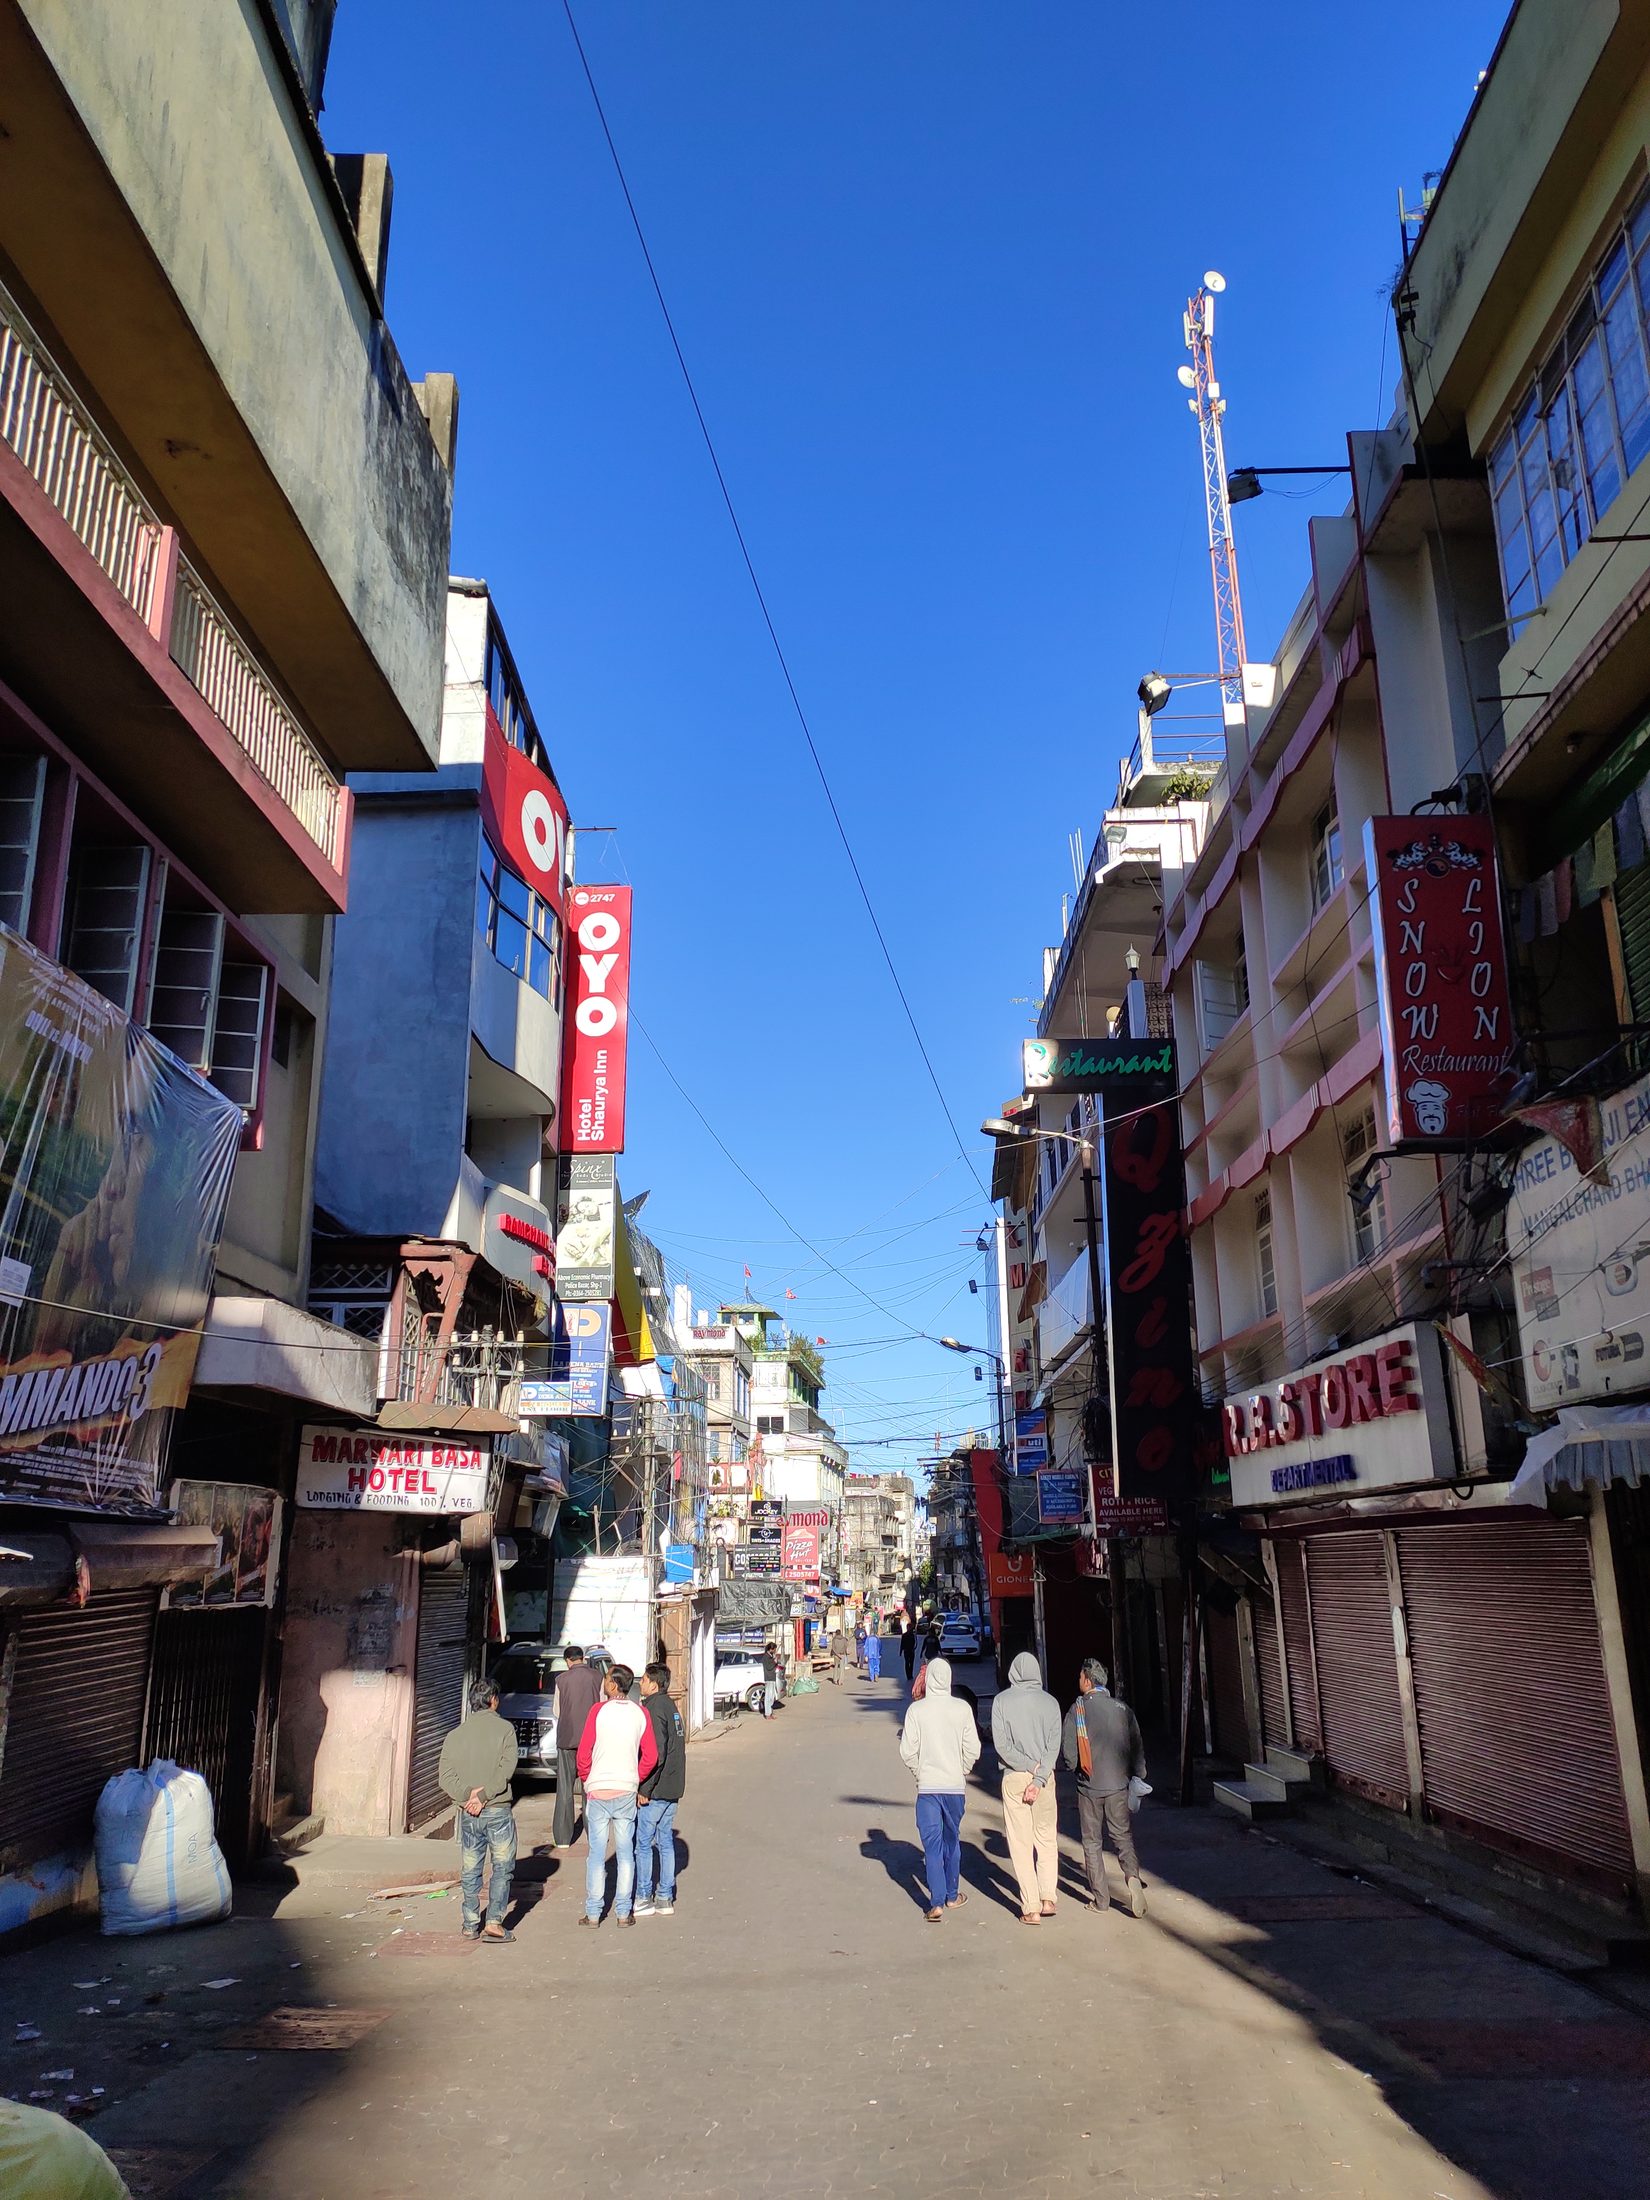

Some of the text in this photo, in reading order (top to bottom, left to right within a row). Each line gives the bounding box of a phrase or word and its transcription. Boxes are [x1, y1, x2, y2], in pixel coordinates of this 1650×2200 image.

[590, 893, 615, 903] 2747
[575, 912, 621, 1037] OYO
[595, 1049, 608, 1075] Inn
[1402, 1044, 1510, 1077] Restaurant
[577, 1098, 592, 1142] Hotel
[591, 1078, 608, 1142] Shaurya
[1514, 1146, 1557, 1195] HREE
[129, 1343, 162, 1421] 3
[312, 1435, 481, 1470] MARWARI BASA
[348, 1468, 437, 1494] HOTEL
[1099, 1506, 1164, 1517] AVAILABLE HERE
[786, 1540, 814, 1551] Pizza
[790, 1548, 811, 1560] Hut
